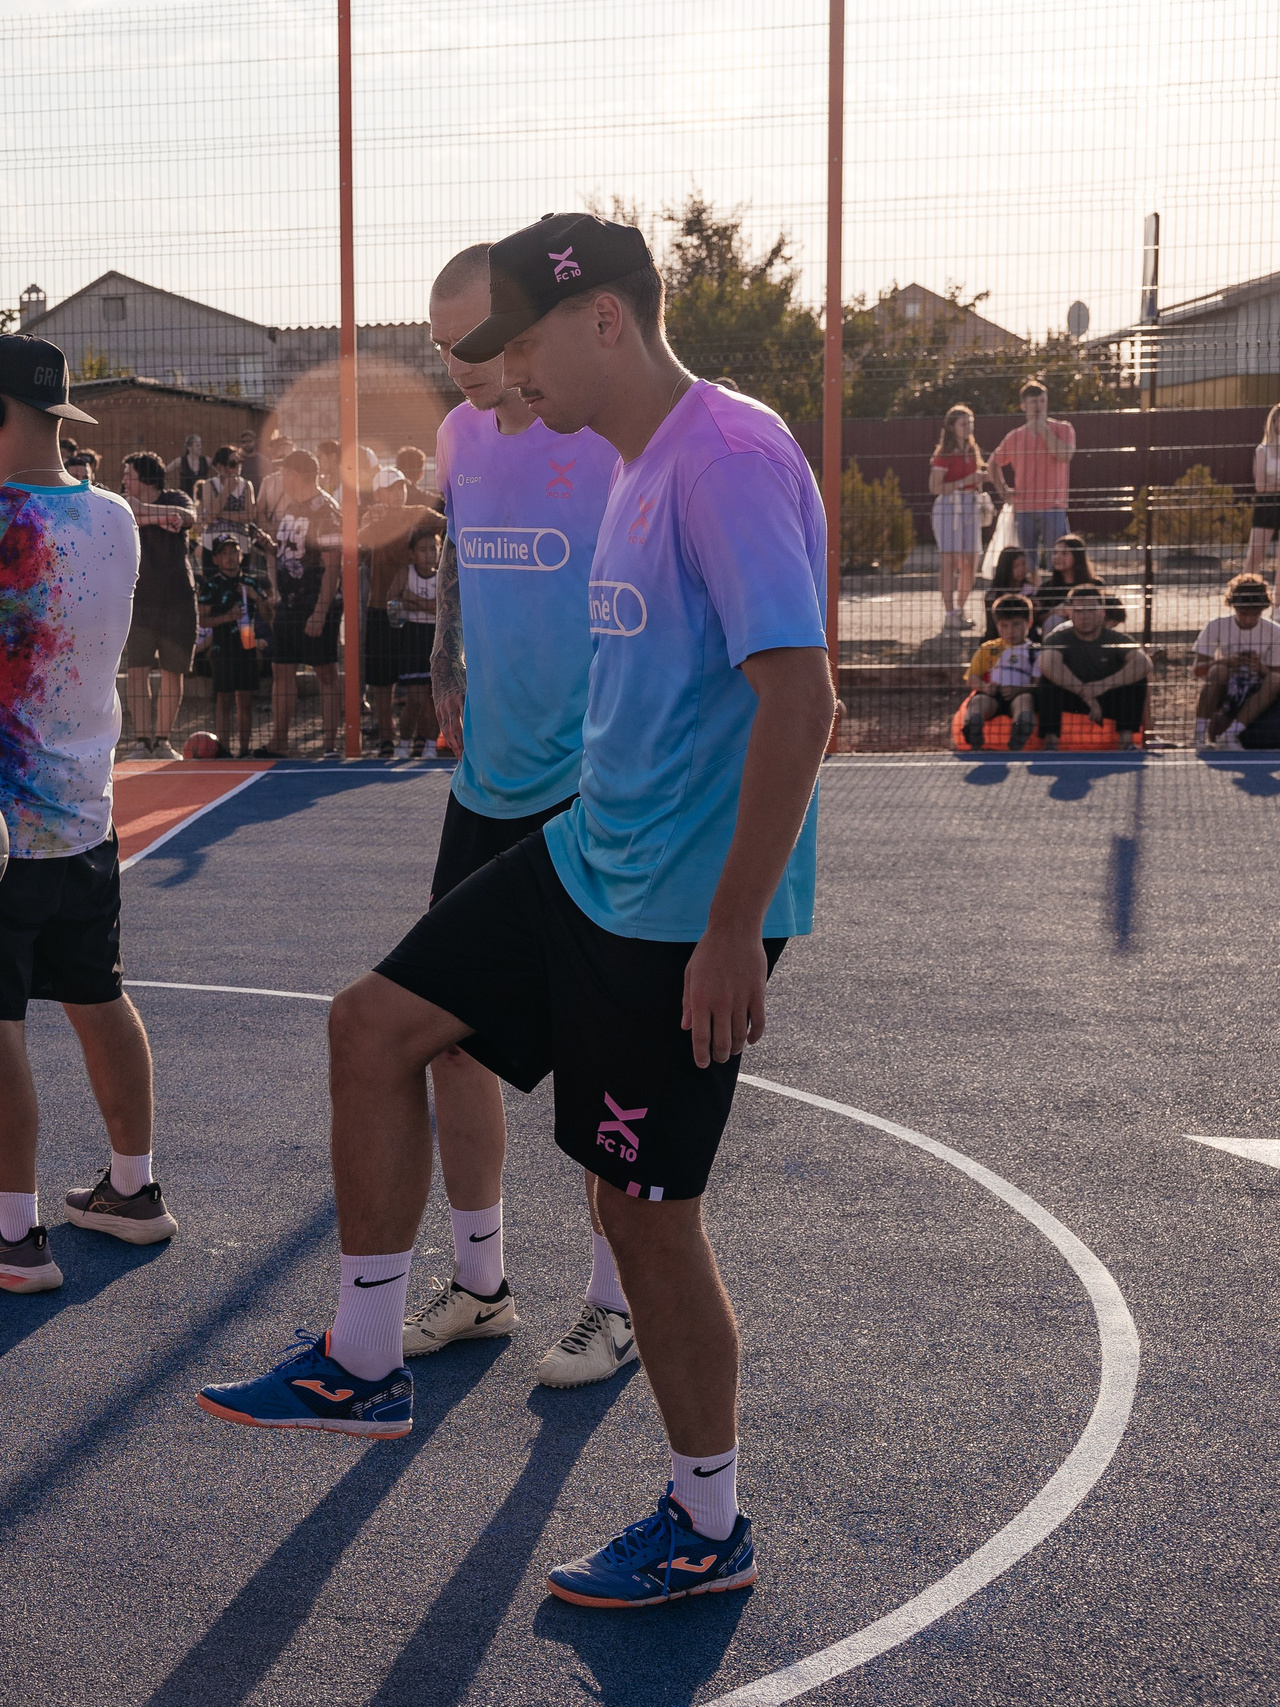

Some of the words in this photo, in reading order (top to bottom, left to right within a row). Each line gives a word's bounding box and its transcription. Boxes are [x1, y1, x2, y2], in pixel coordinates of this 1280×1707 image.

[556, 272, 570, 283] FC
[570, 268, 582, 278] 10
[463, 537, 529, 560] Winline
[596, 1132, 616, 1153] FC
[620, 1144, 638, 1163] 10
